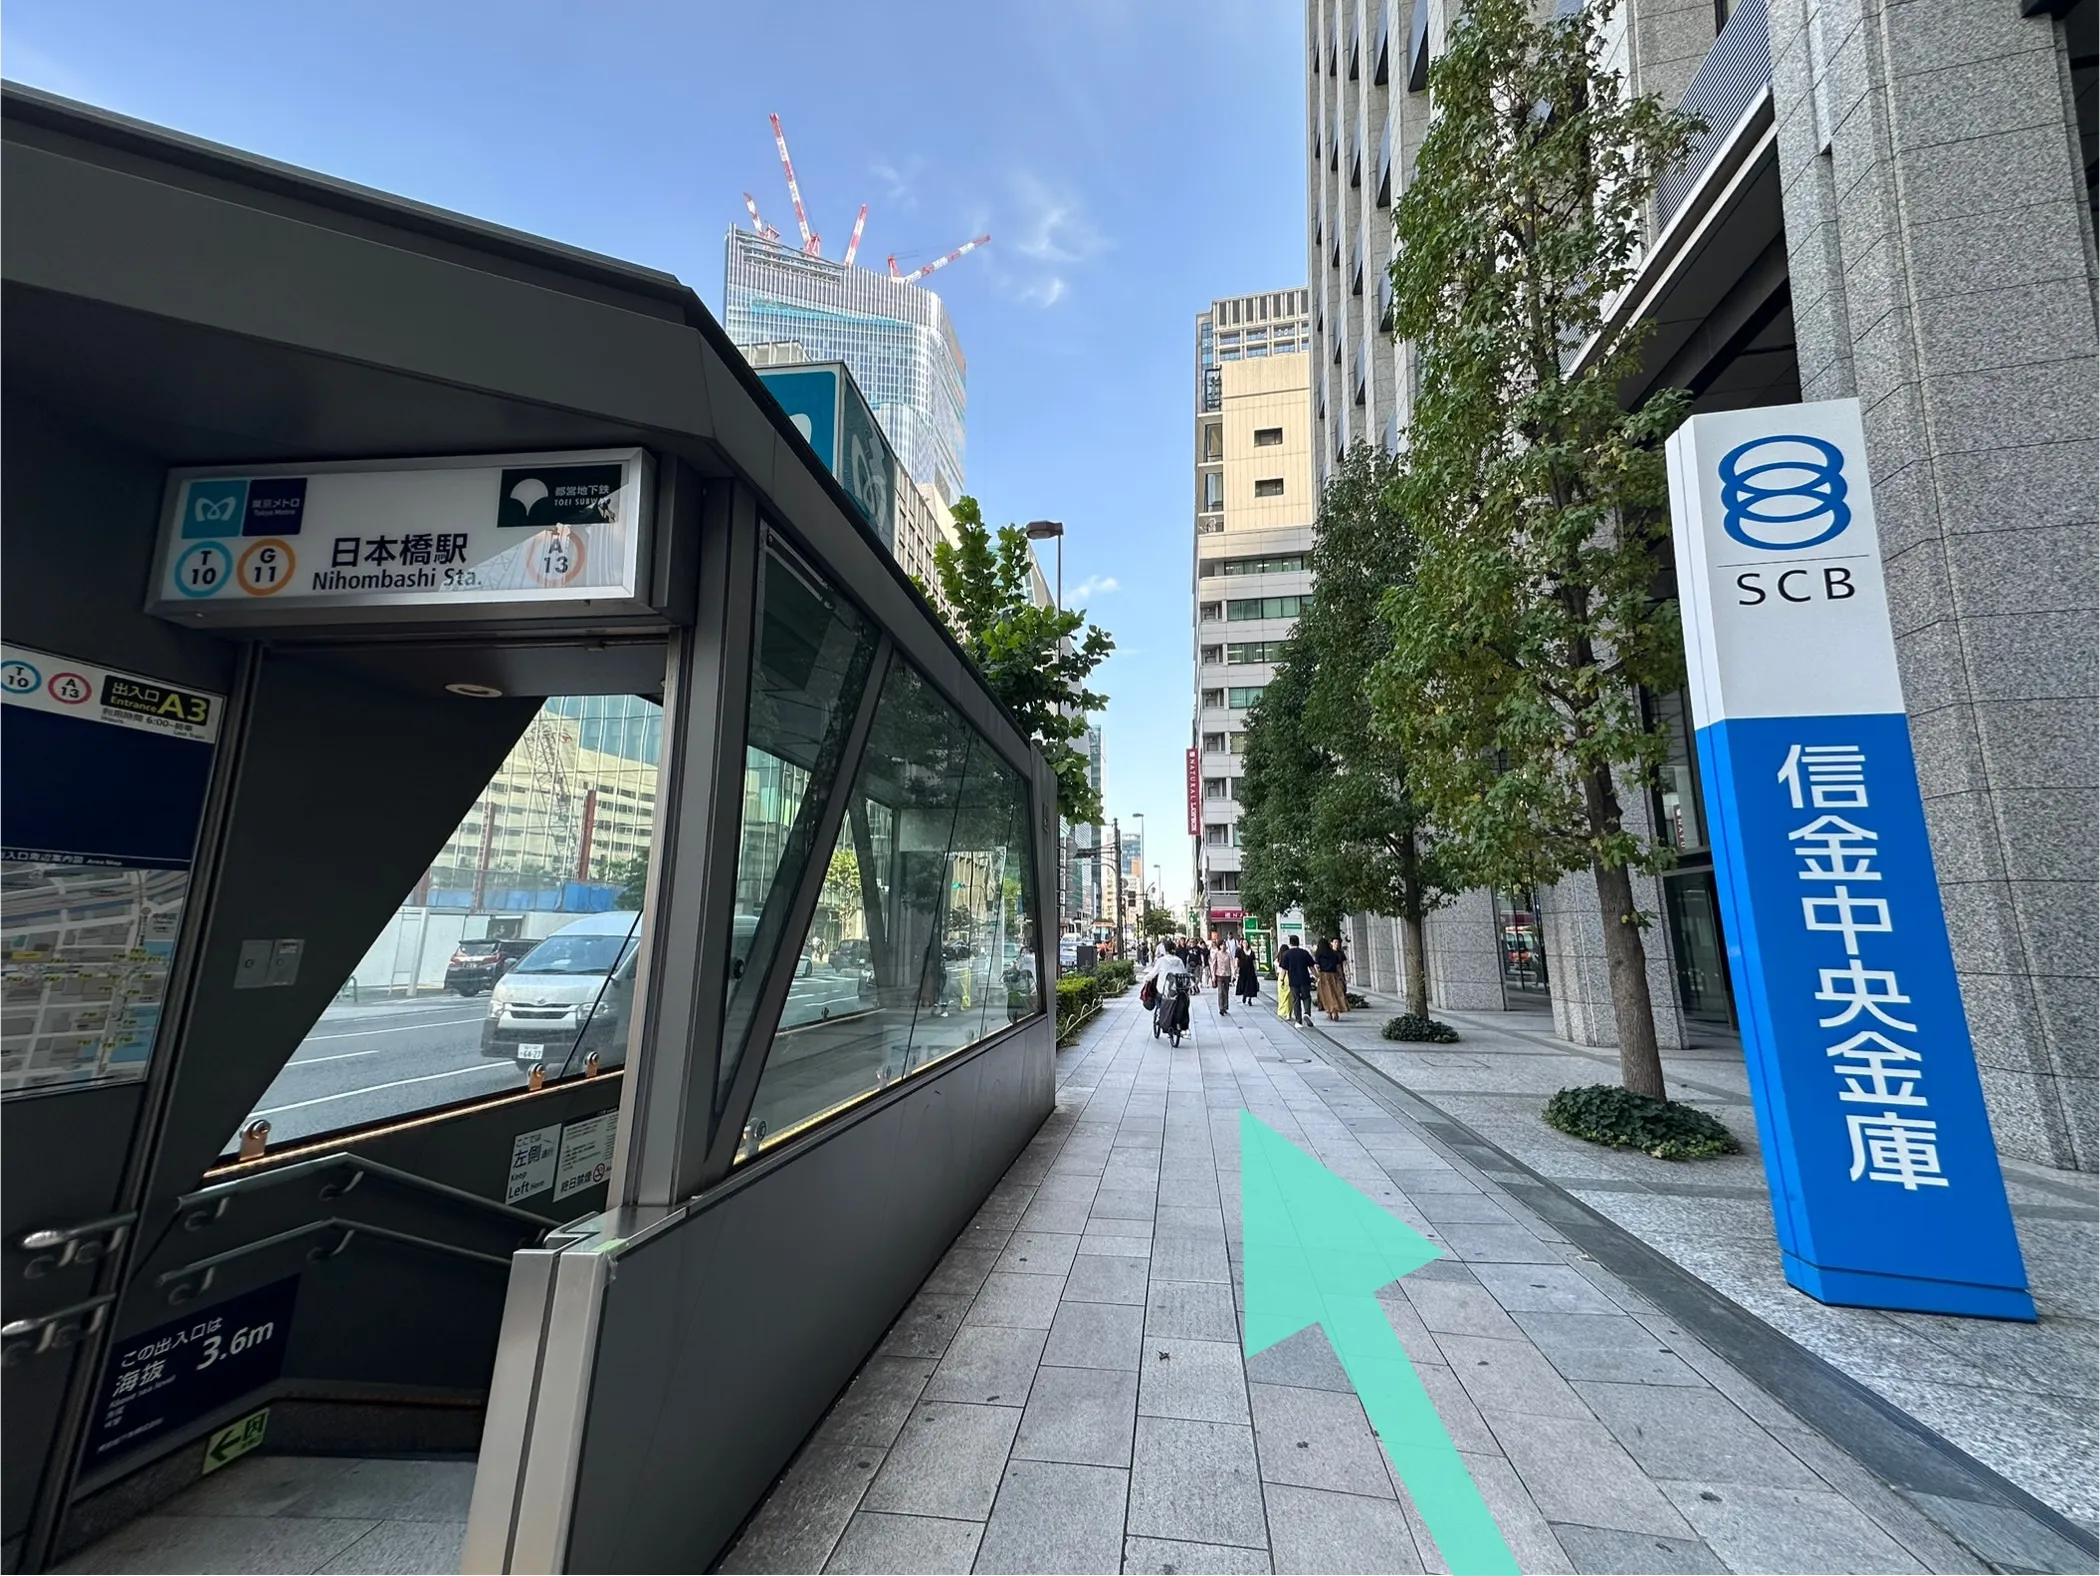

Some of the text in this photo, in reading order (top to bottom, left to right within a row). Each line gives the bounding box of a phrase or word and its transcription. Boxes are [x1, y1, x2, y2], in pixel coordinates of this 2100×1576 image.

[555, 484, 610, 497] 都営地下鉄
[252, 498, 300, 509] 東京メトロ
[554, 498, 572, 507] TOEI
[331, 533, 468, 568] 日本橋駅
[547, 537, 562, 554] A
[201, 551, 211, 565] T
[260, 550, 275, 564] G
[542, 556, 568, 574] 13
[191, 568, 217, 585] 10
[254, 566, 277, 583] 11
[312, 568, 482, 591] Nihombashi Sta.
[1736, 568, 1857, 607] SCB
[16, 667, 24, 677] T
[8, 676, 29, 688] 10
[66, 679, 76, 688] A
[60, 687, 80, 698] 13
[112, 682, 159, 702] 出入口
[110, 696, 158, 713] Entrance
[157, 693, 207, 722] A3
[1777, 743, 1950, 1192] 信金中央金庫
[508, 1181, 530, 1199] Left
[121, 1317, 223, 1367] この出入口は
[196, 1322, 274, 1370] 3.6m
